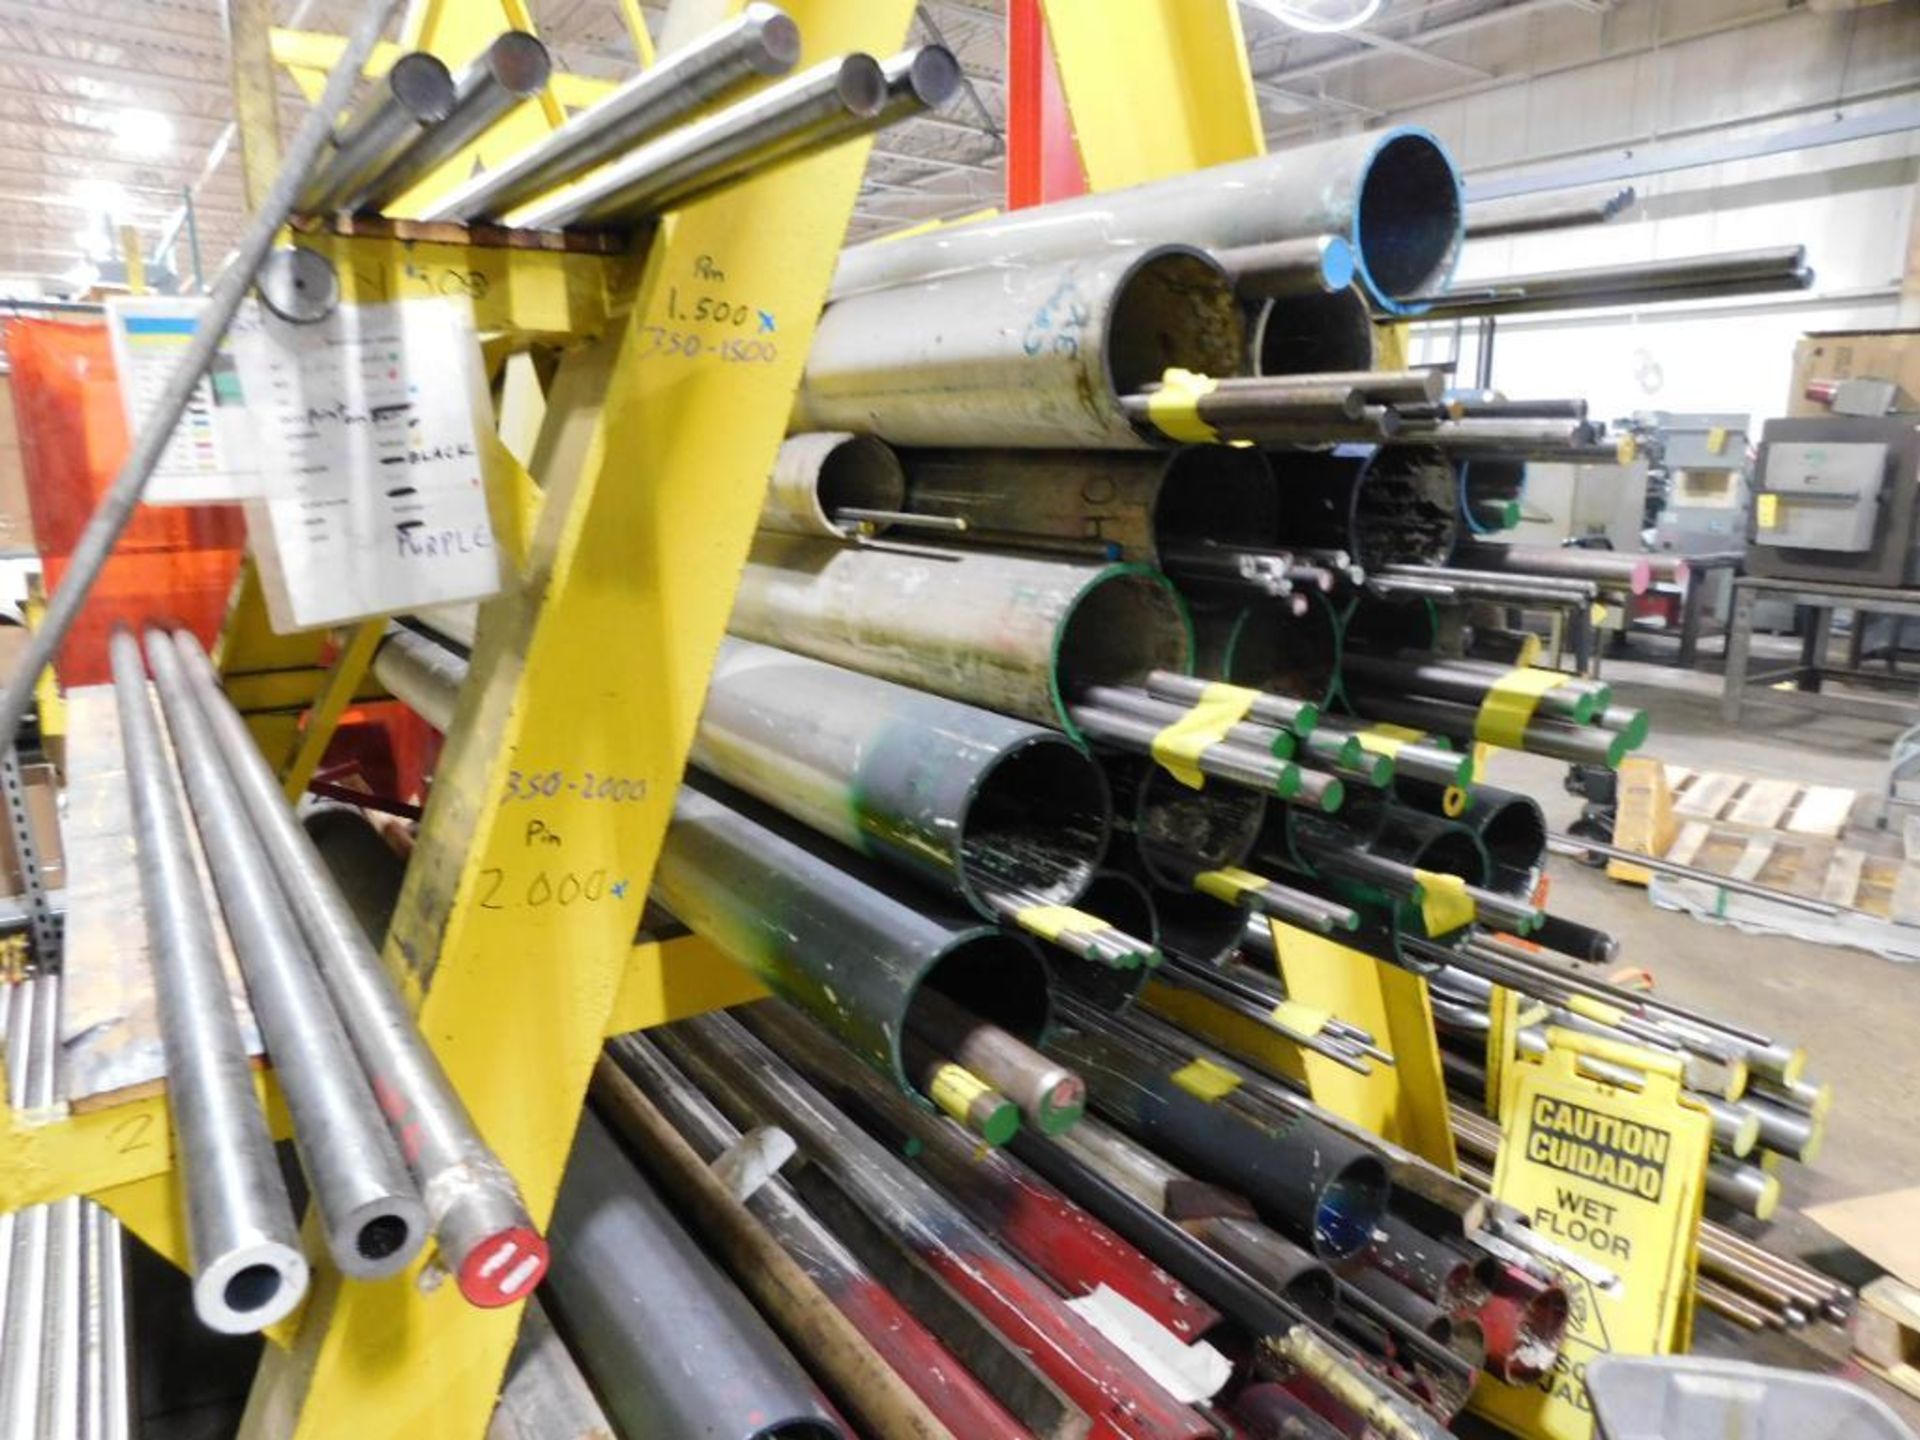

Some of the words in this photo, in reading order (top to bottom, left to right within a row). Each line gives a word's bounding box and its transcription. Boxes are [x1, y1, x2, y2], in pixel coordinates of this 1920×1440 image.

[501, 770, 648, 806] 350-2000
[526, 819, 562, 846] Pin
[1533, 1098, 1667, 1164] CAUTION
[1529, 1131, 1661, 1200] CUIDADO
[1556, 1186, 1618, 1226] WET
[1534, 1207, 1632, 1261] FLOOR
[1552, 1351, 1588, 1382] SO
